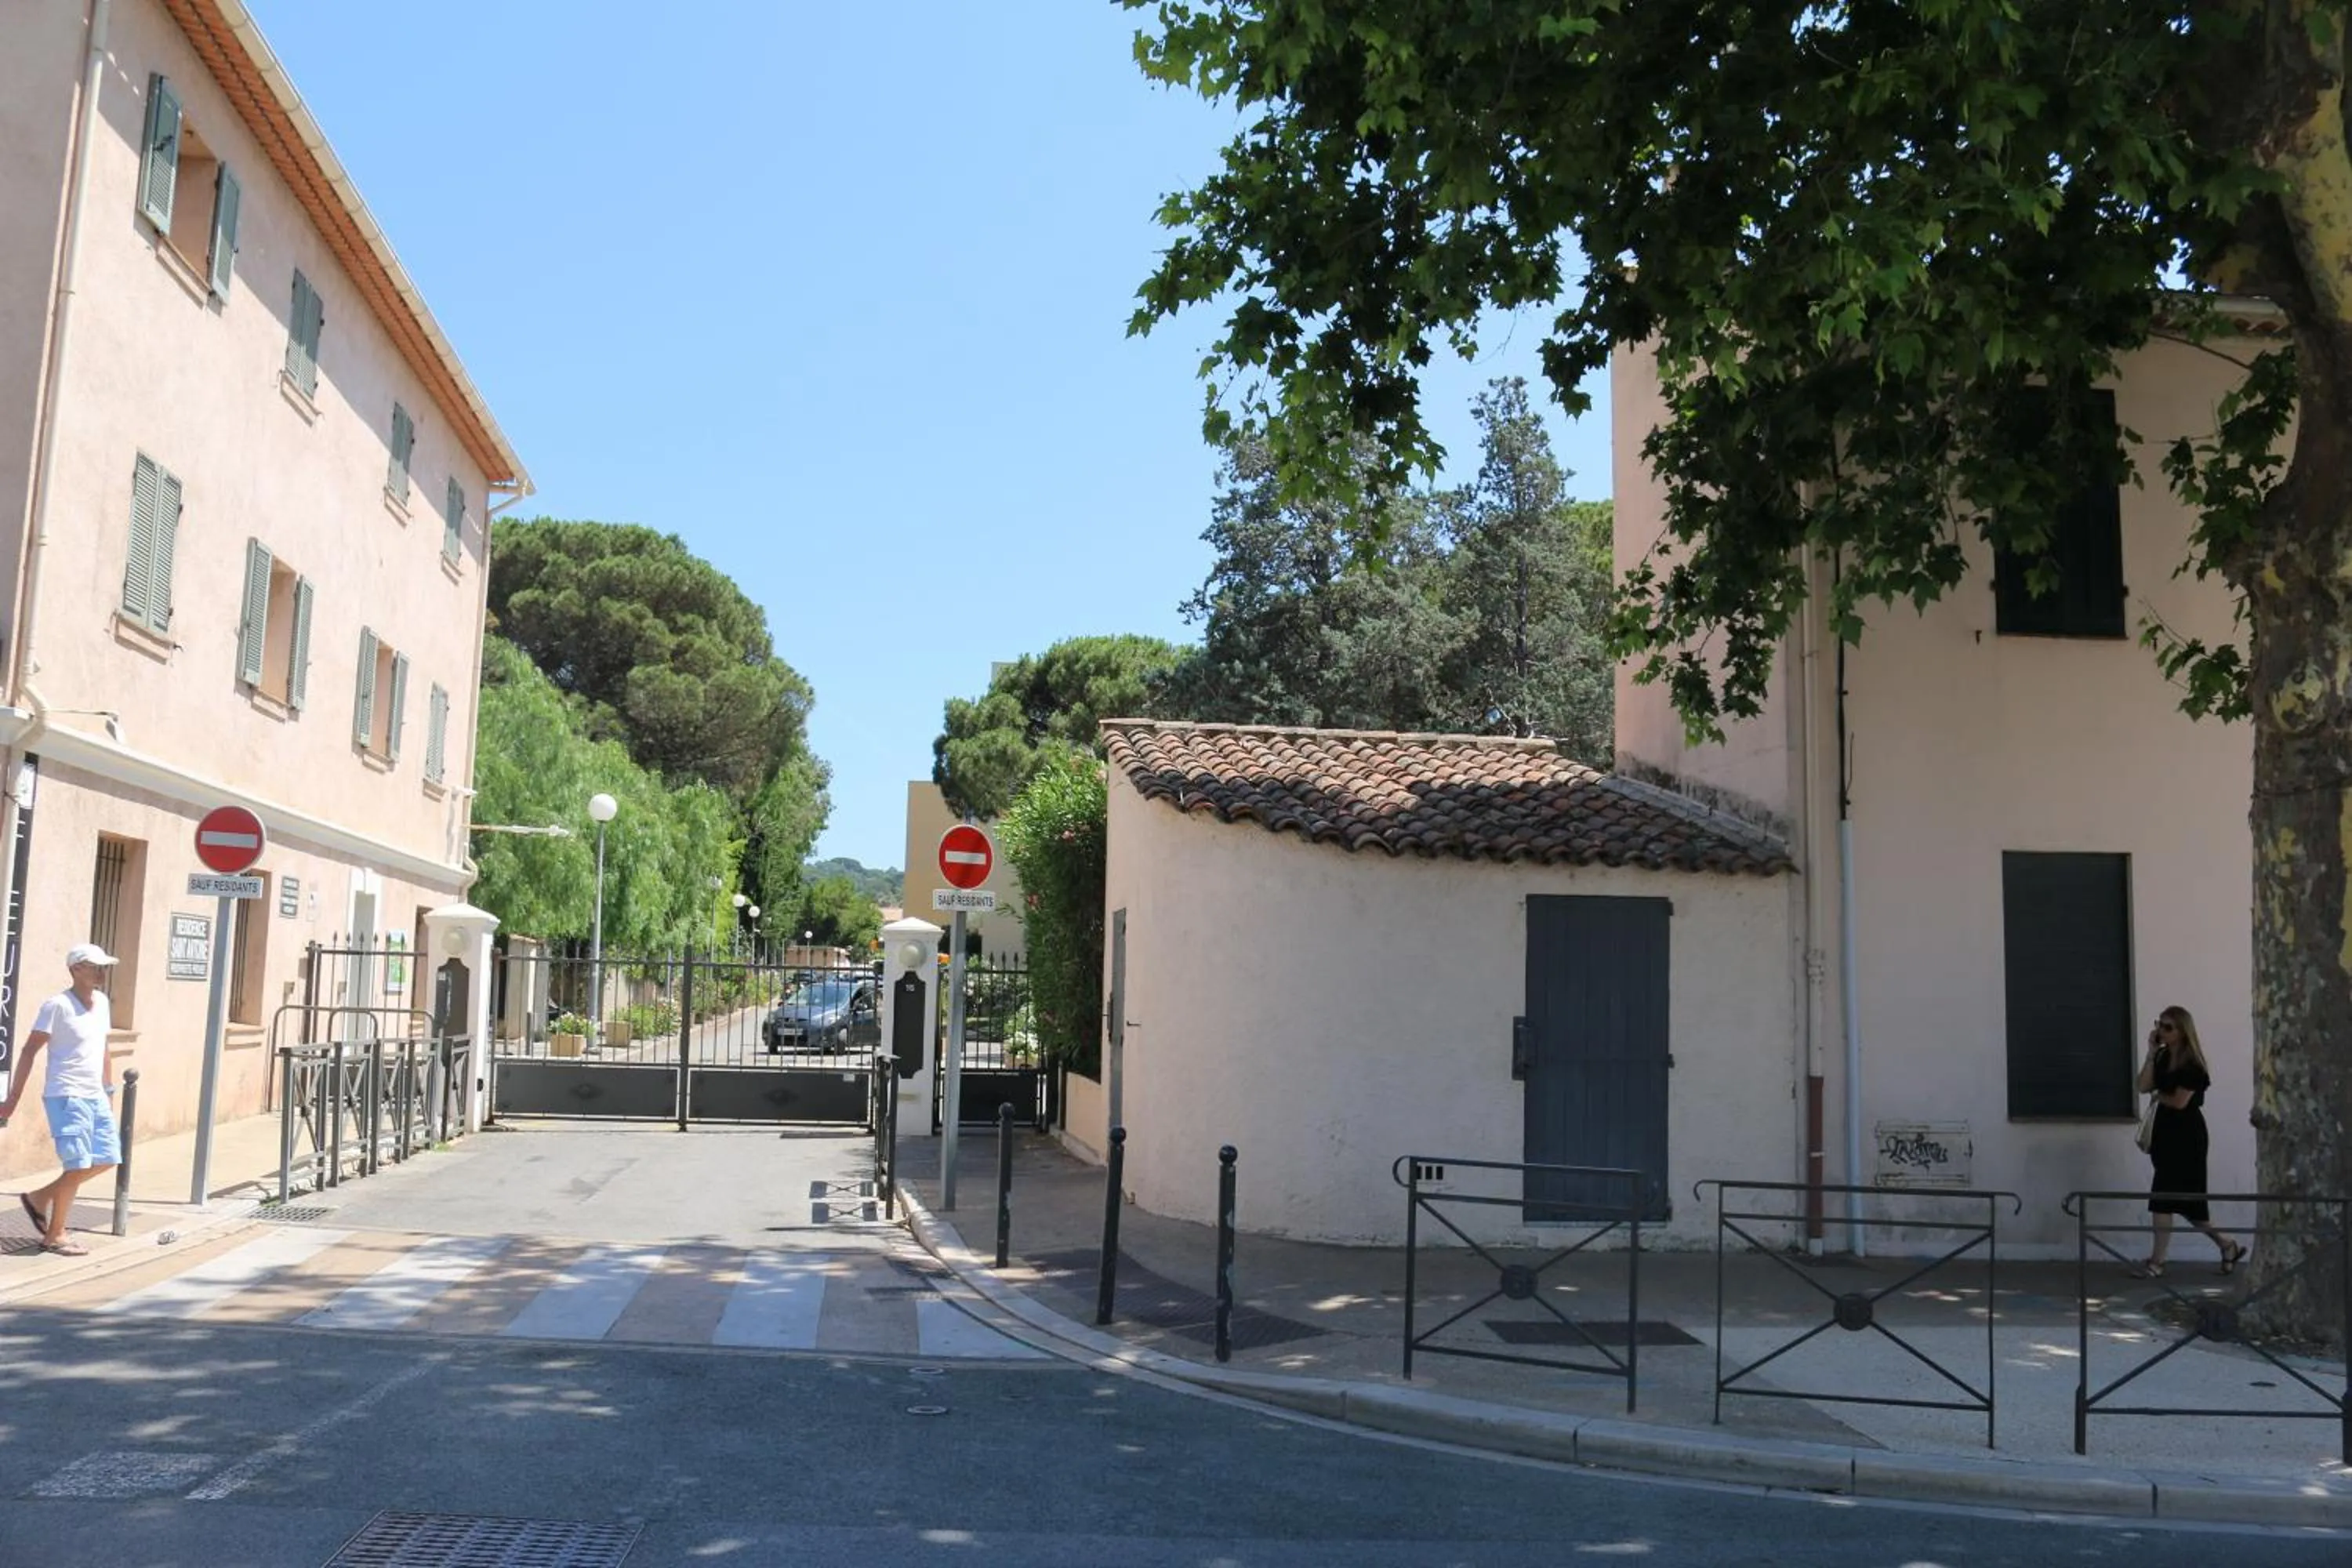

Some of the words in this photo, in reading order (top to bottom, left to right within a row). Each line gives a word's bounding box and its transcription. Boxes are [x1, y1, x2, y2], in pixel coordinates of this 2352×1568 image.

[191, 879, 212, 891] SAUF
[214, 880, 258, 893] RESIDANTS
[938, 895, 956, 906] SAUF
